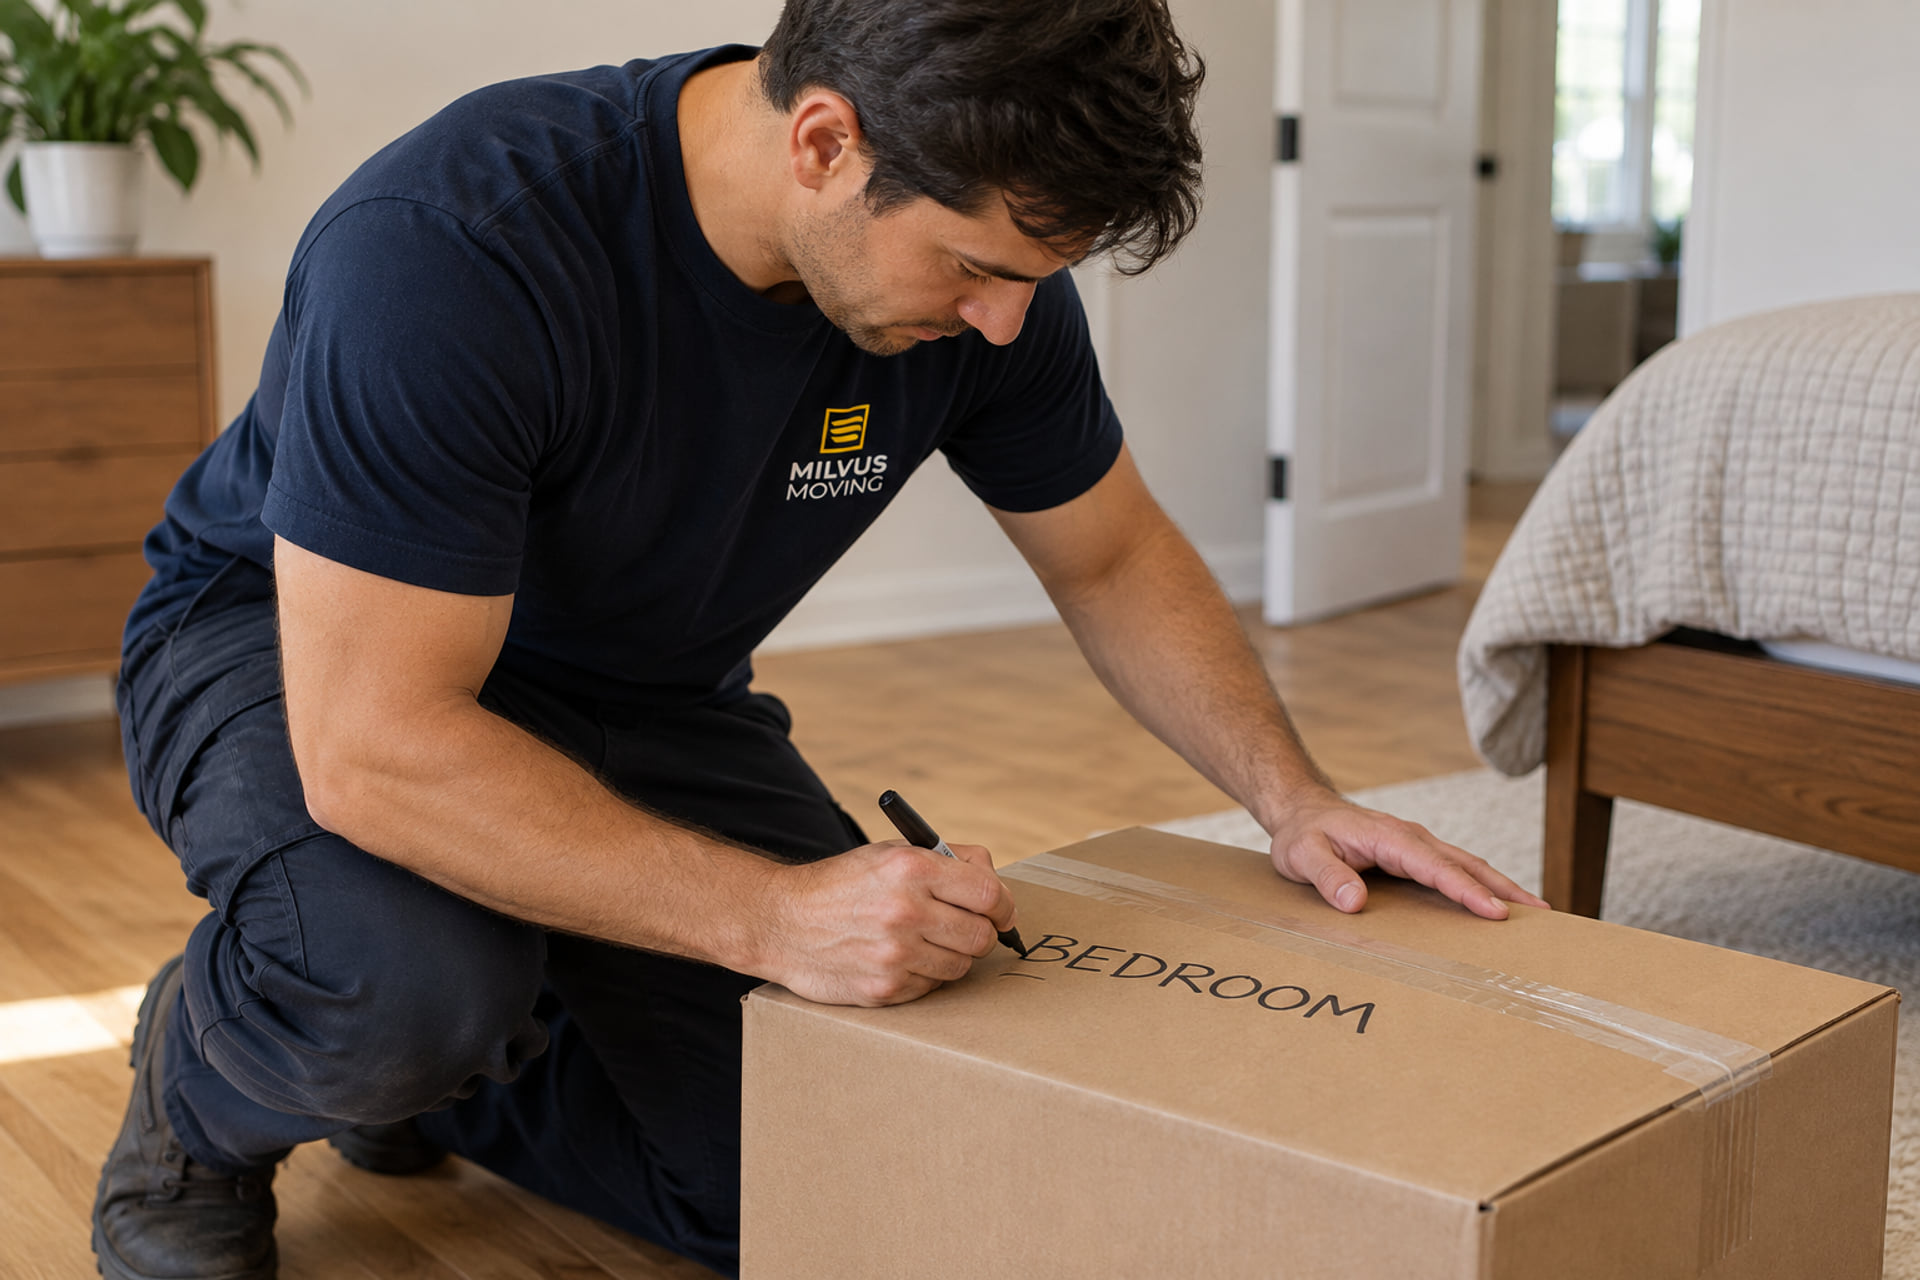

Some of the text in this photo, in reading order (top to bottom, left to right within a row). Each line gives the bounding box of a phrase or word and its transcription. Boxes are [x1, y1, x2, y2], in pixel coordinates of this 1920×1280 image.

[790, 454, 888, 481] MILVUS
[785, 475, 884, 501] MOVING
[1023, 934, 1376, 1034] BEDROOM
